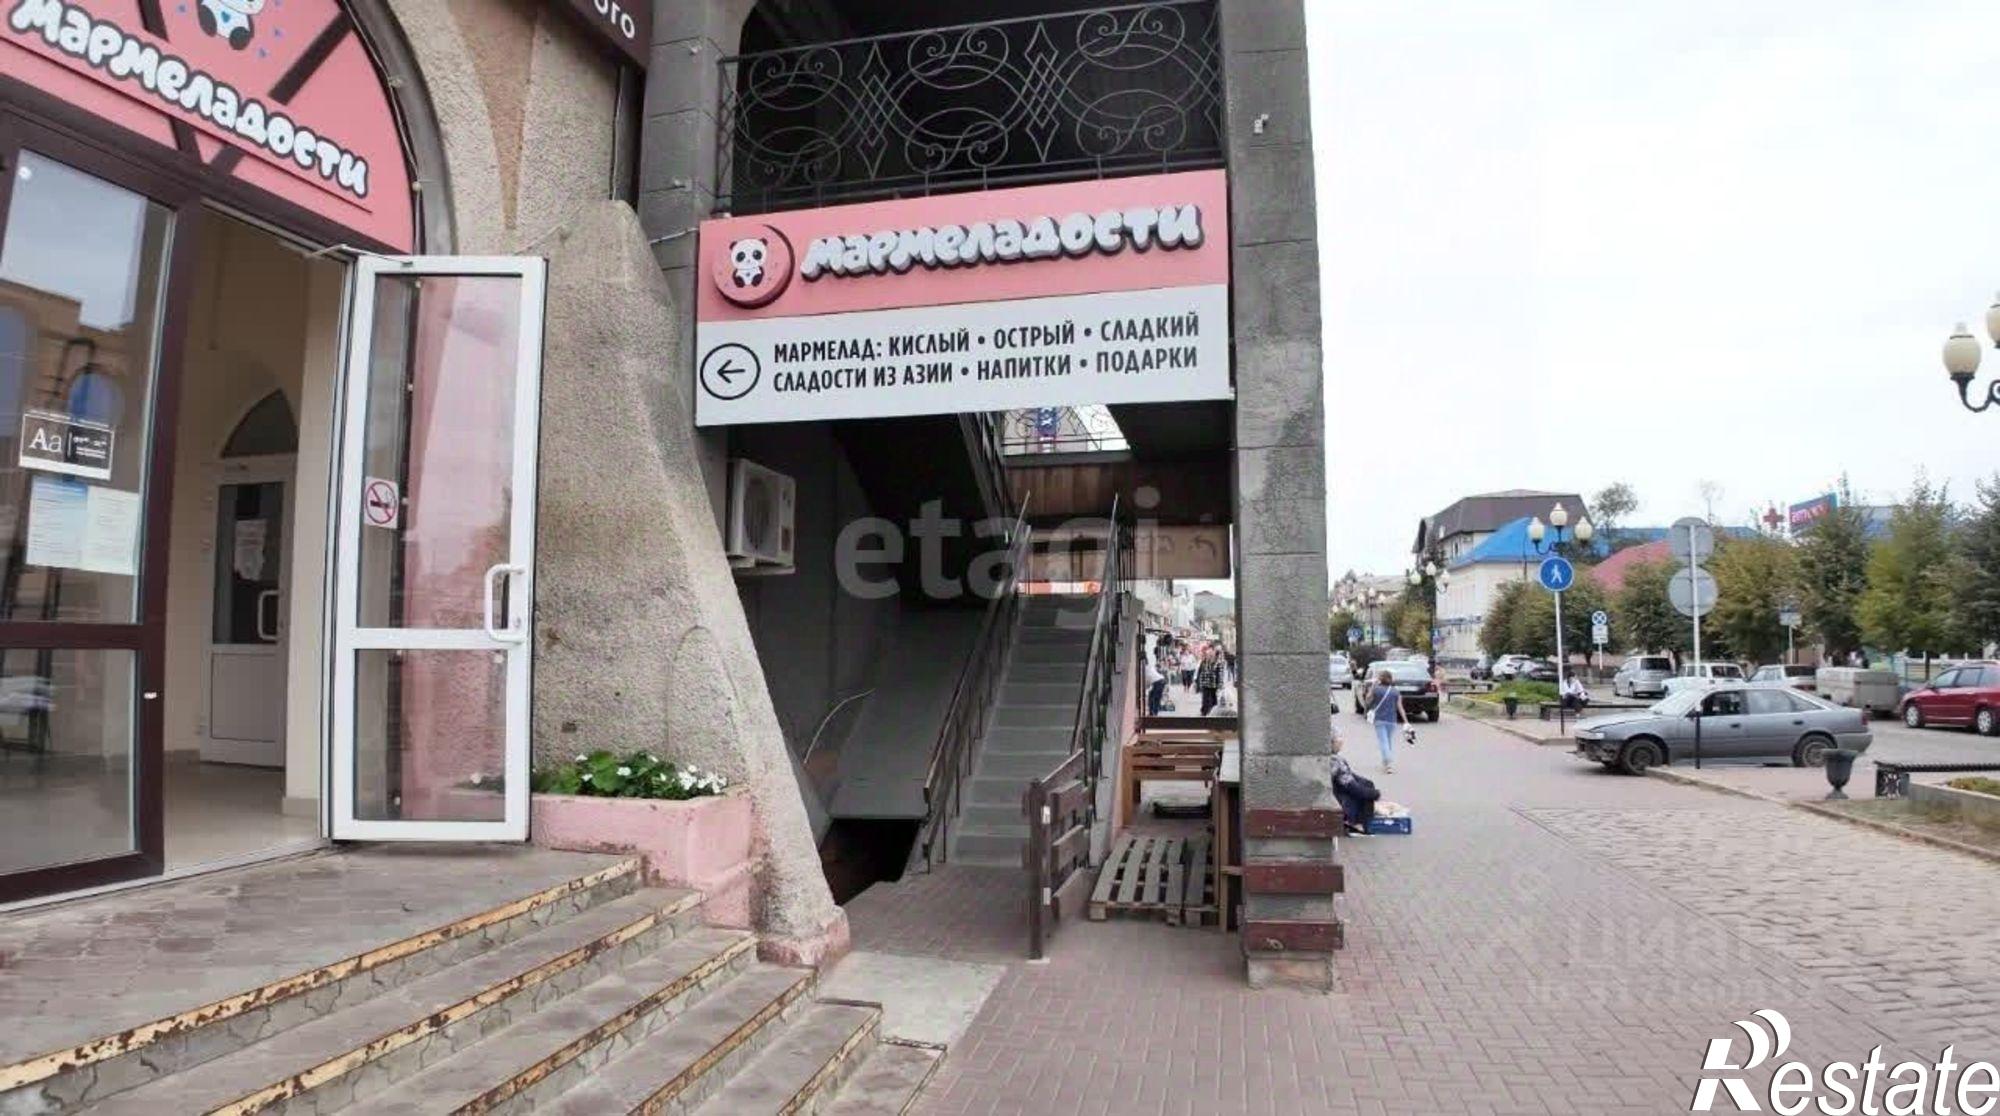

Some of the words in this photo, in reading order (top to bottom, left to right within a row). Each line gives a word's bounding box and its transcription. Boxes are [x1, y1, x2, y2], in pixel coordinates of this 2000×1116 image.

[774, 338, 882, 363] МАРМЕЛАД:
[888, 328, 970, 357] КИСЛЫЙ
[993, 320, 1075, 349] ОСТРЫЙ
[1100, 311, 1200, 342] СЛАДКИЙ
[773, 367, 867, 393] СЛАДОСТИ
[873, 366, 896, 387] ИЗ
[902, 362, 953, 385] АЗИИ
[976, 354, 1072, 381] НАПИТКИ
[1096, 346, 1198, 374] ПОДАРКИ
